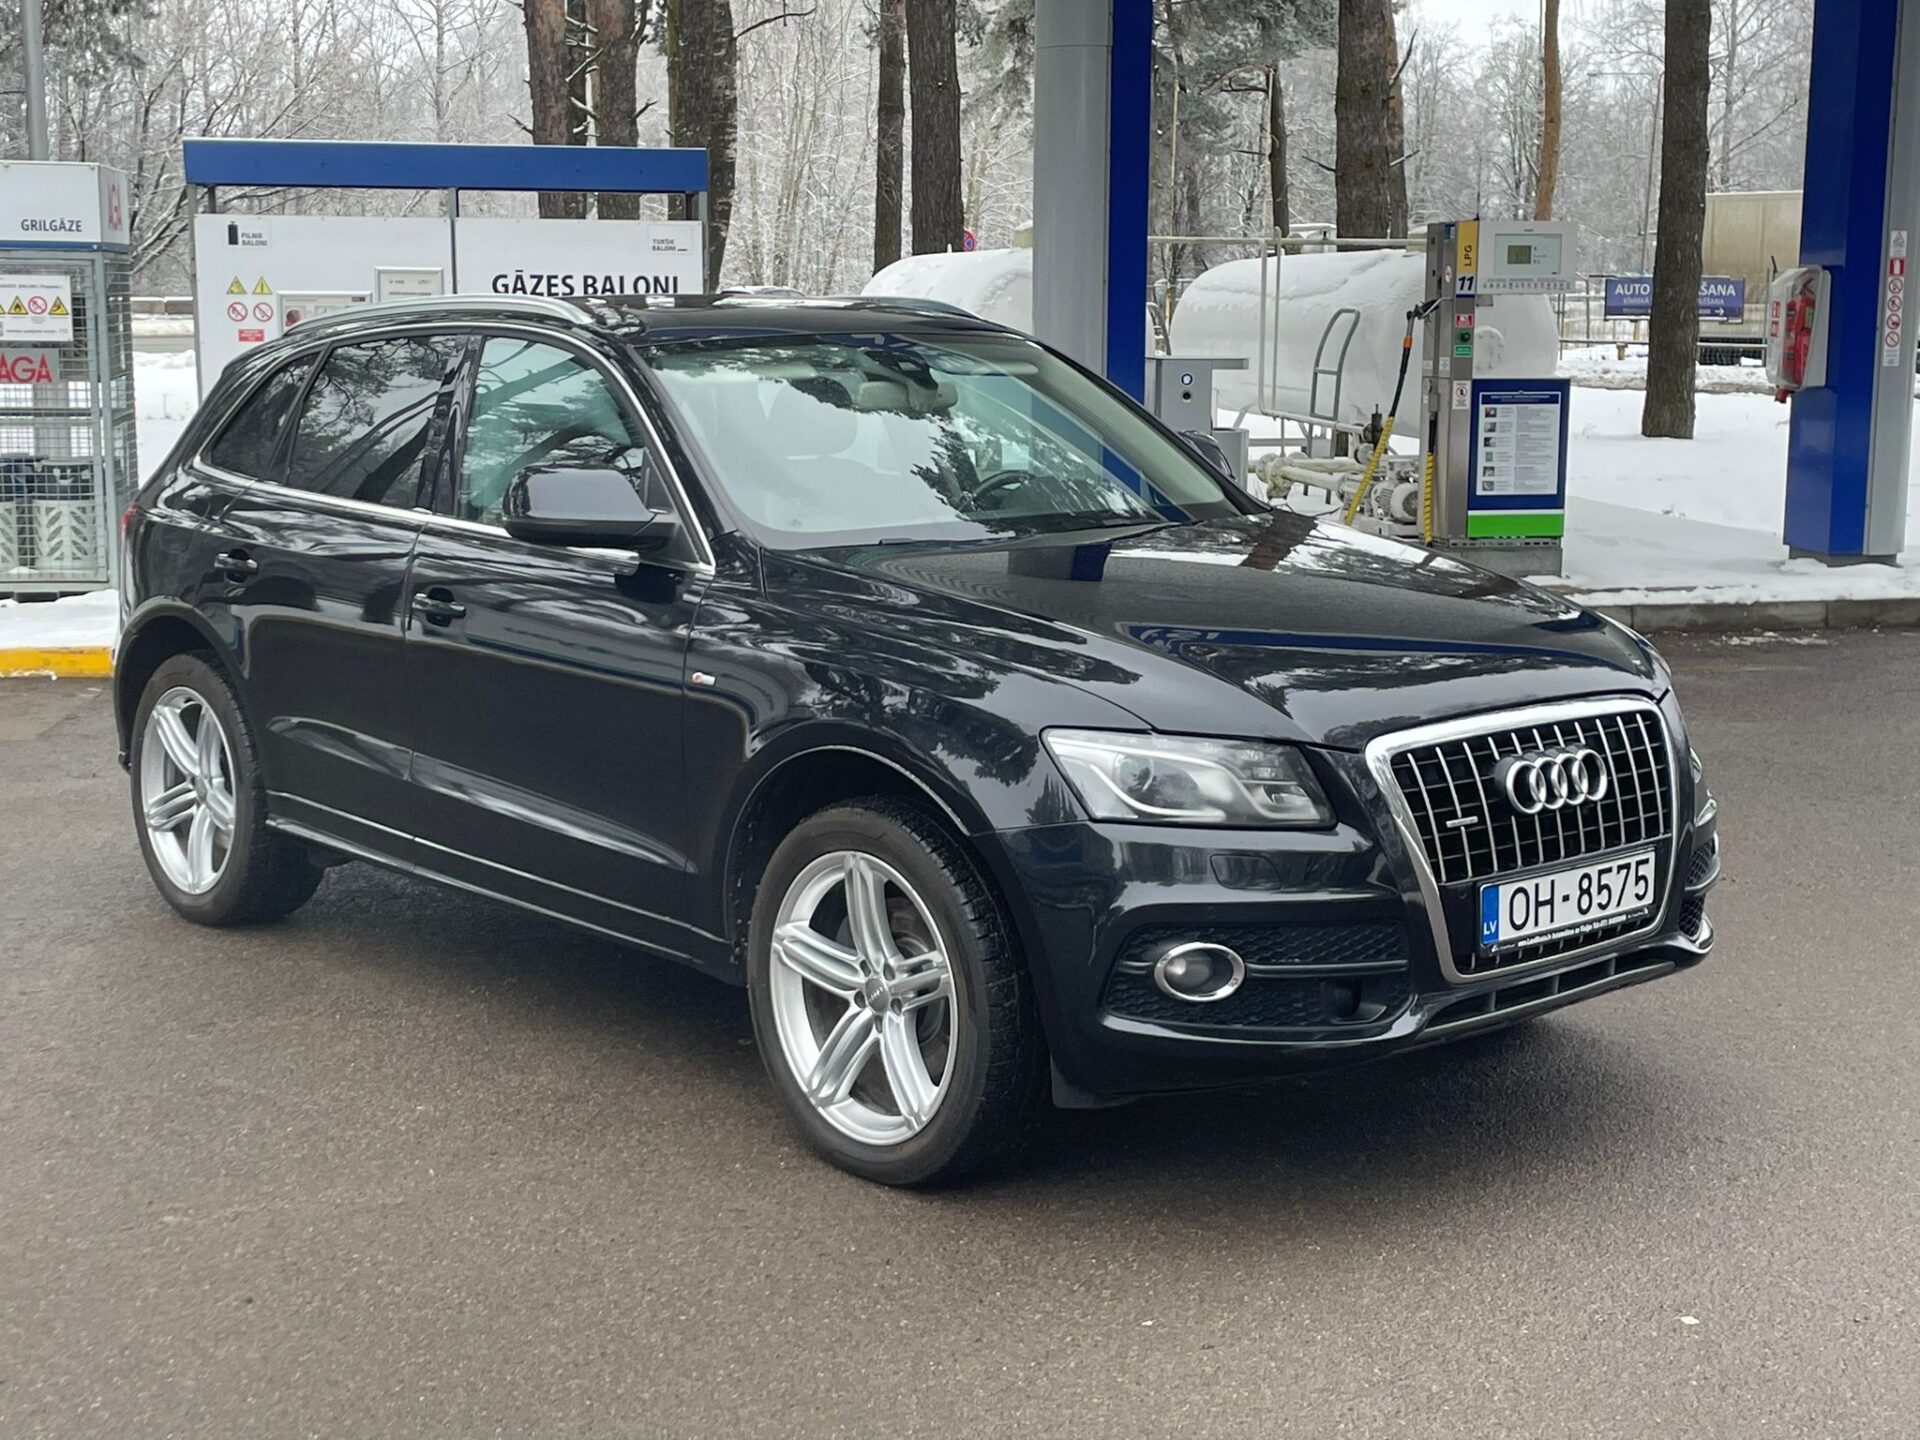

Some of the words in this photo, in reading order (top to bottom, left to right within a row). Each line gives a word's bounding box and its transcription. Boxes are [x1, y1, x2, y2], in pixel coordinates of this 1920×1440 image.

[1464, 245, 1473, 266] LPG
[492, 270, 575, 297] GĀZES
[583, 275, 679, 297] BALONI
[1458, 276, 1474, 291] 11
[1508, 858, 1650, 931] OH-8575
[1483, 920, 1497, 936] LV
